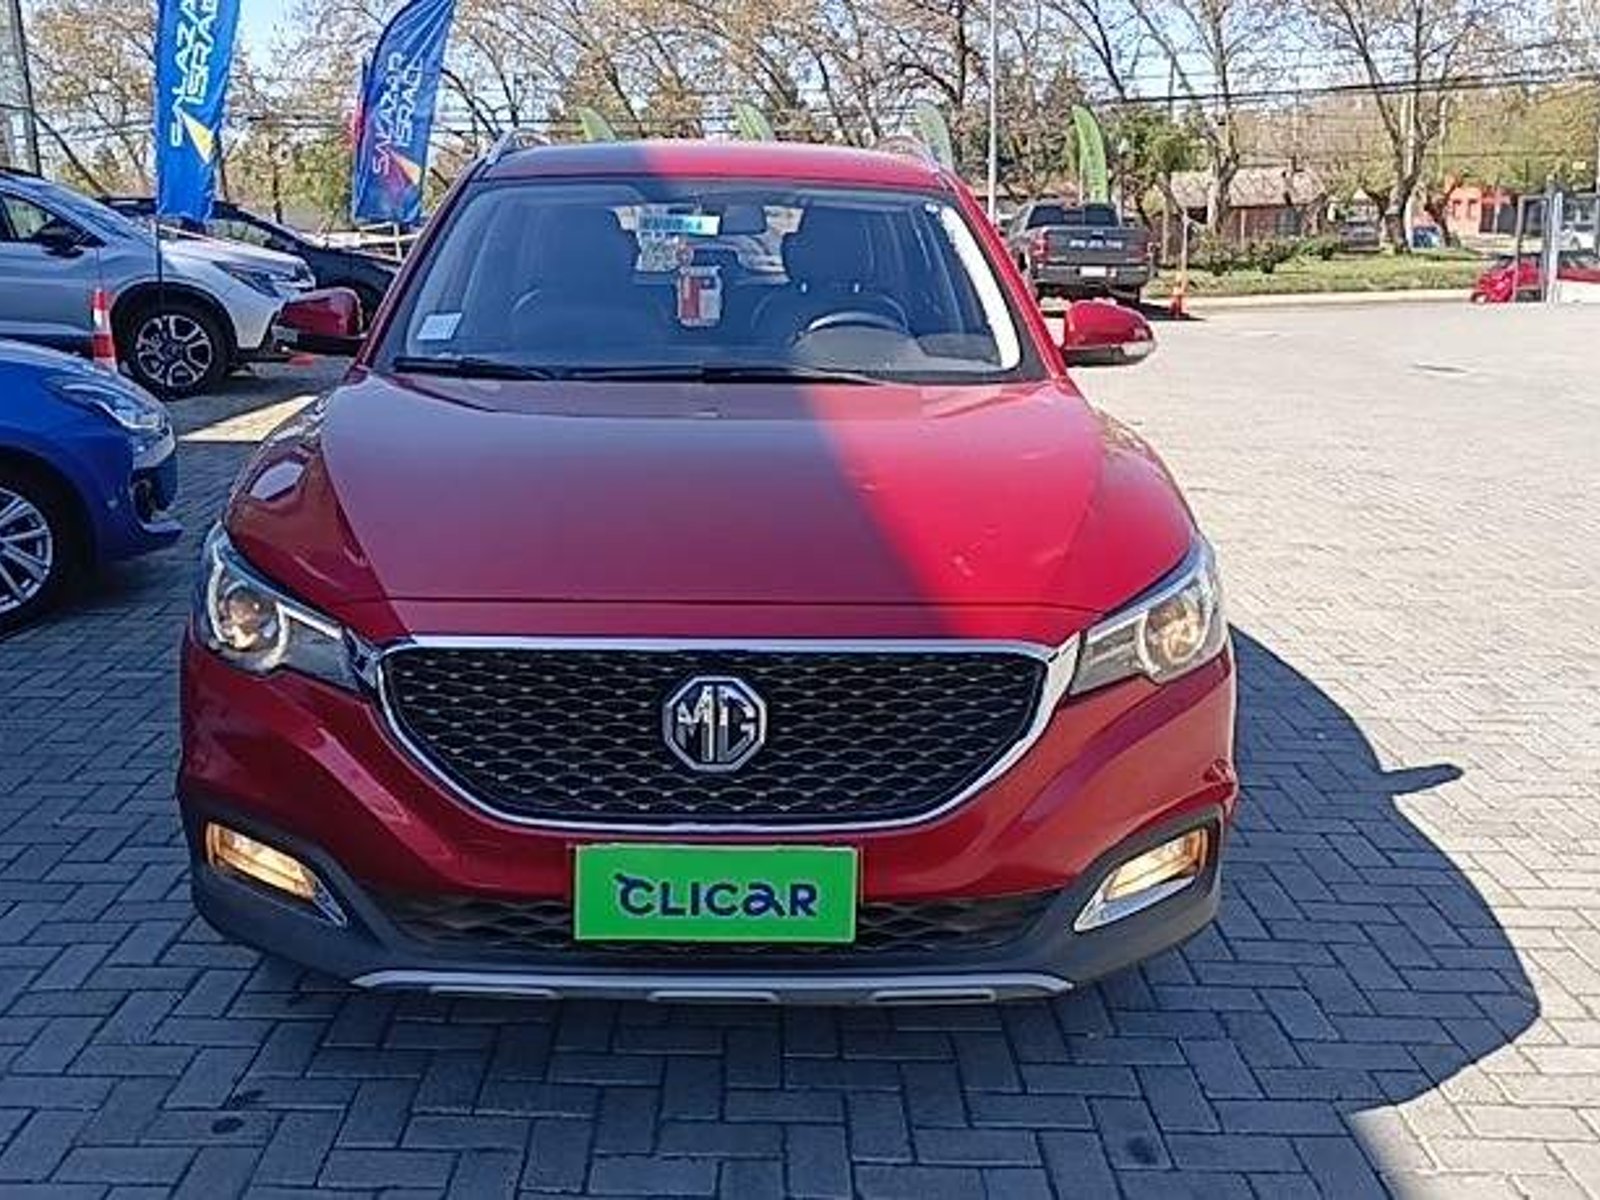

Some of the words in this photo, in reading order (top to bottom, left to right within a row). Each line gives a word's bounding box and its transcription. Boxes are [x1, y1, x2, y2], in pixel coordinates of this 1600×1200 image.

[373, 52, 405, 175] SALAZAR
[394, 57, 422, 146] ISRAEL
[677, 685, 755, 762] MG
